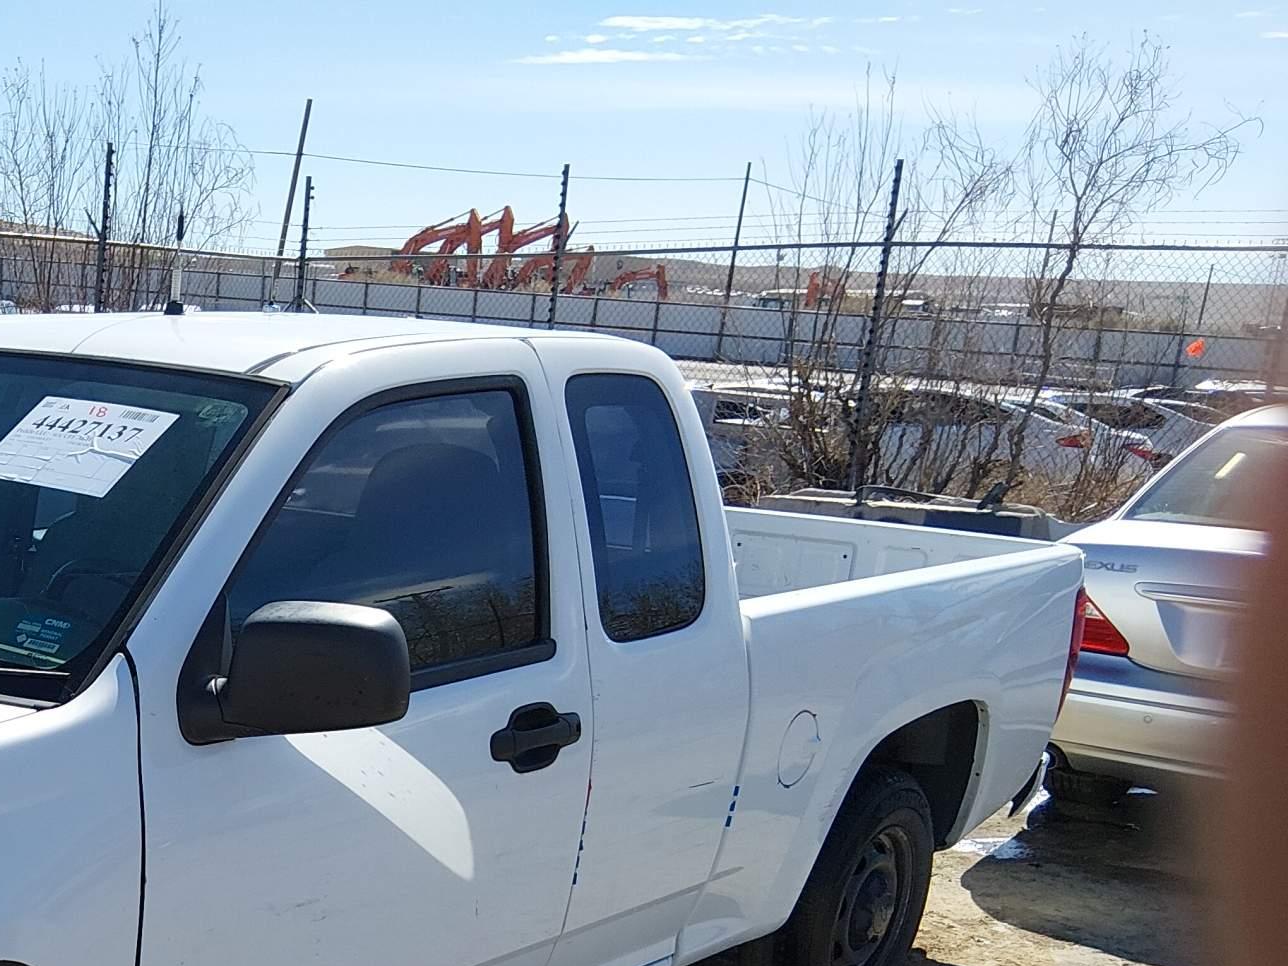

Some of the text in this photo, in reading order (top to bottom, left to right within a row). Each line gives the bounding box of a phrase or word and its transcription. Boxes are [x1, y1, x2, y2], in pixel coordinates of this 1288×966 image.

[87, 405, 109, 418] 18
[32, 415, 145, 443] 44427137
[1084, 560, 1139, 573] EXUS
